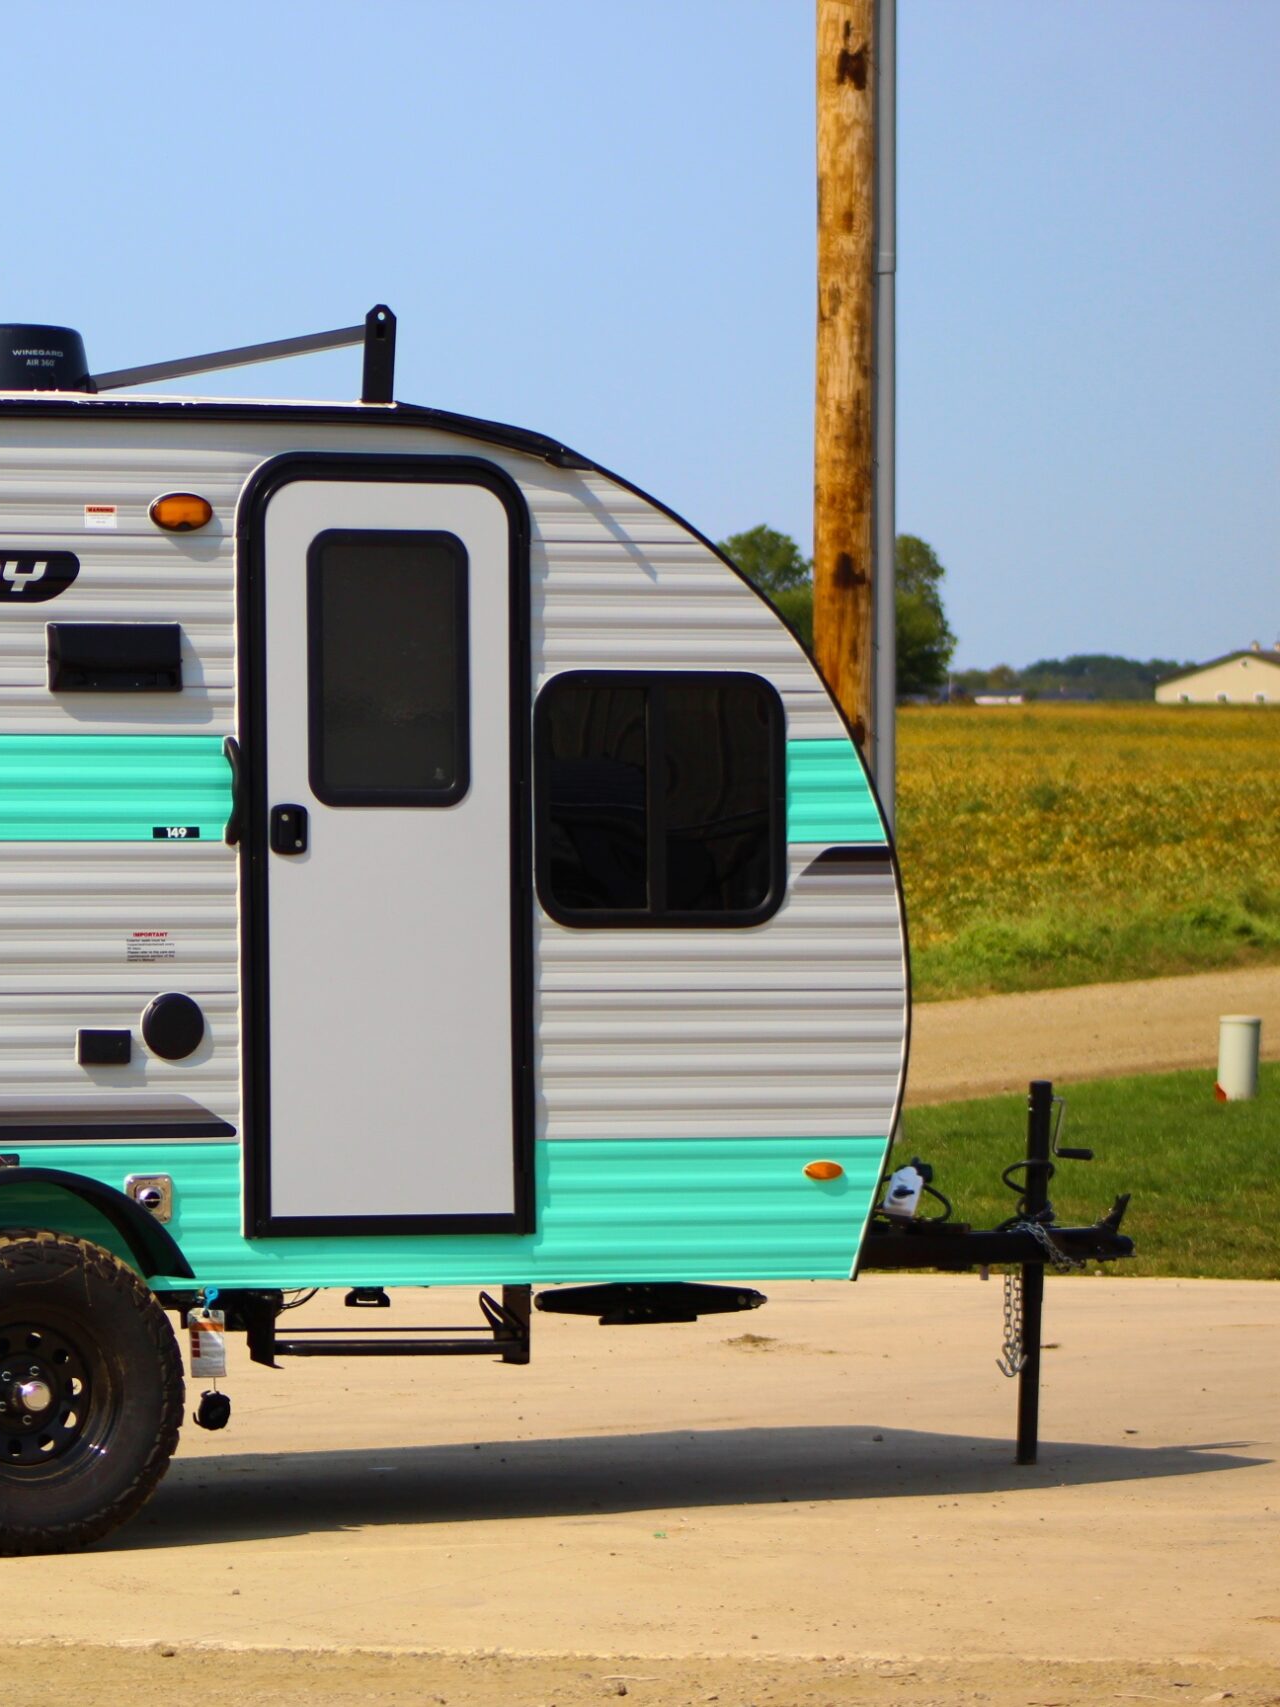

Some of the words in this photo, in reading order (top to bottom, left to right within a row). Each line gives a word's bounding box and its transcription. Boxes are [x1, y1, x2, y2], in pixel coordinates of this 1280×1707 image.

[12, 349, 64, 358] WINEGARD
[26, 359, 39, 367] AIR
[166, 827, 187, 838] 149
